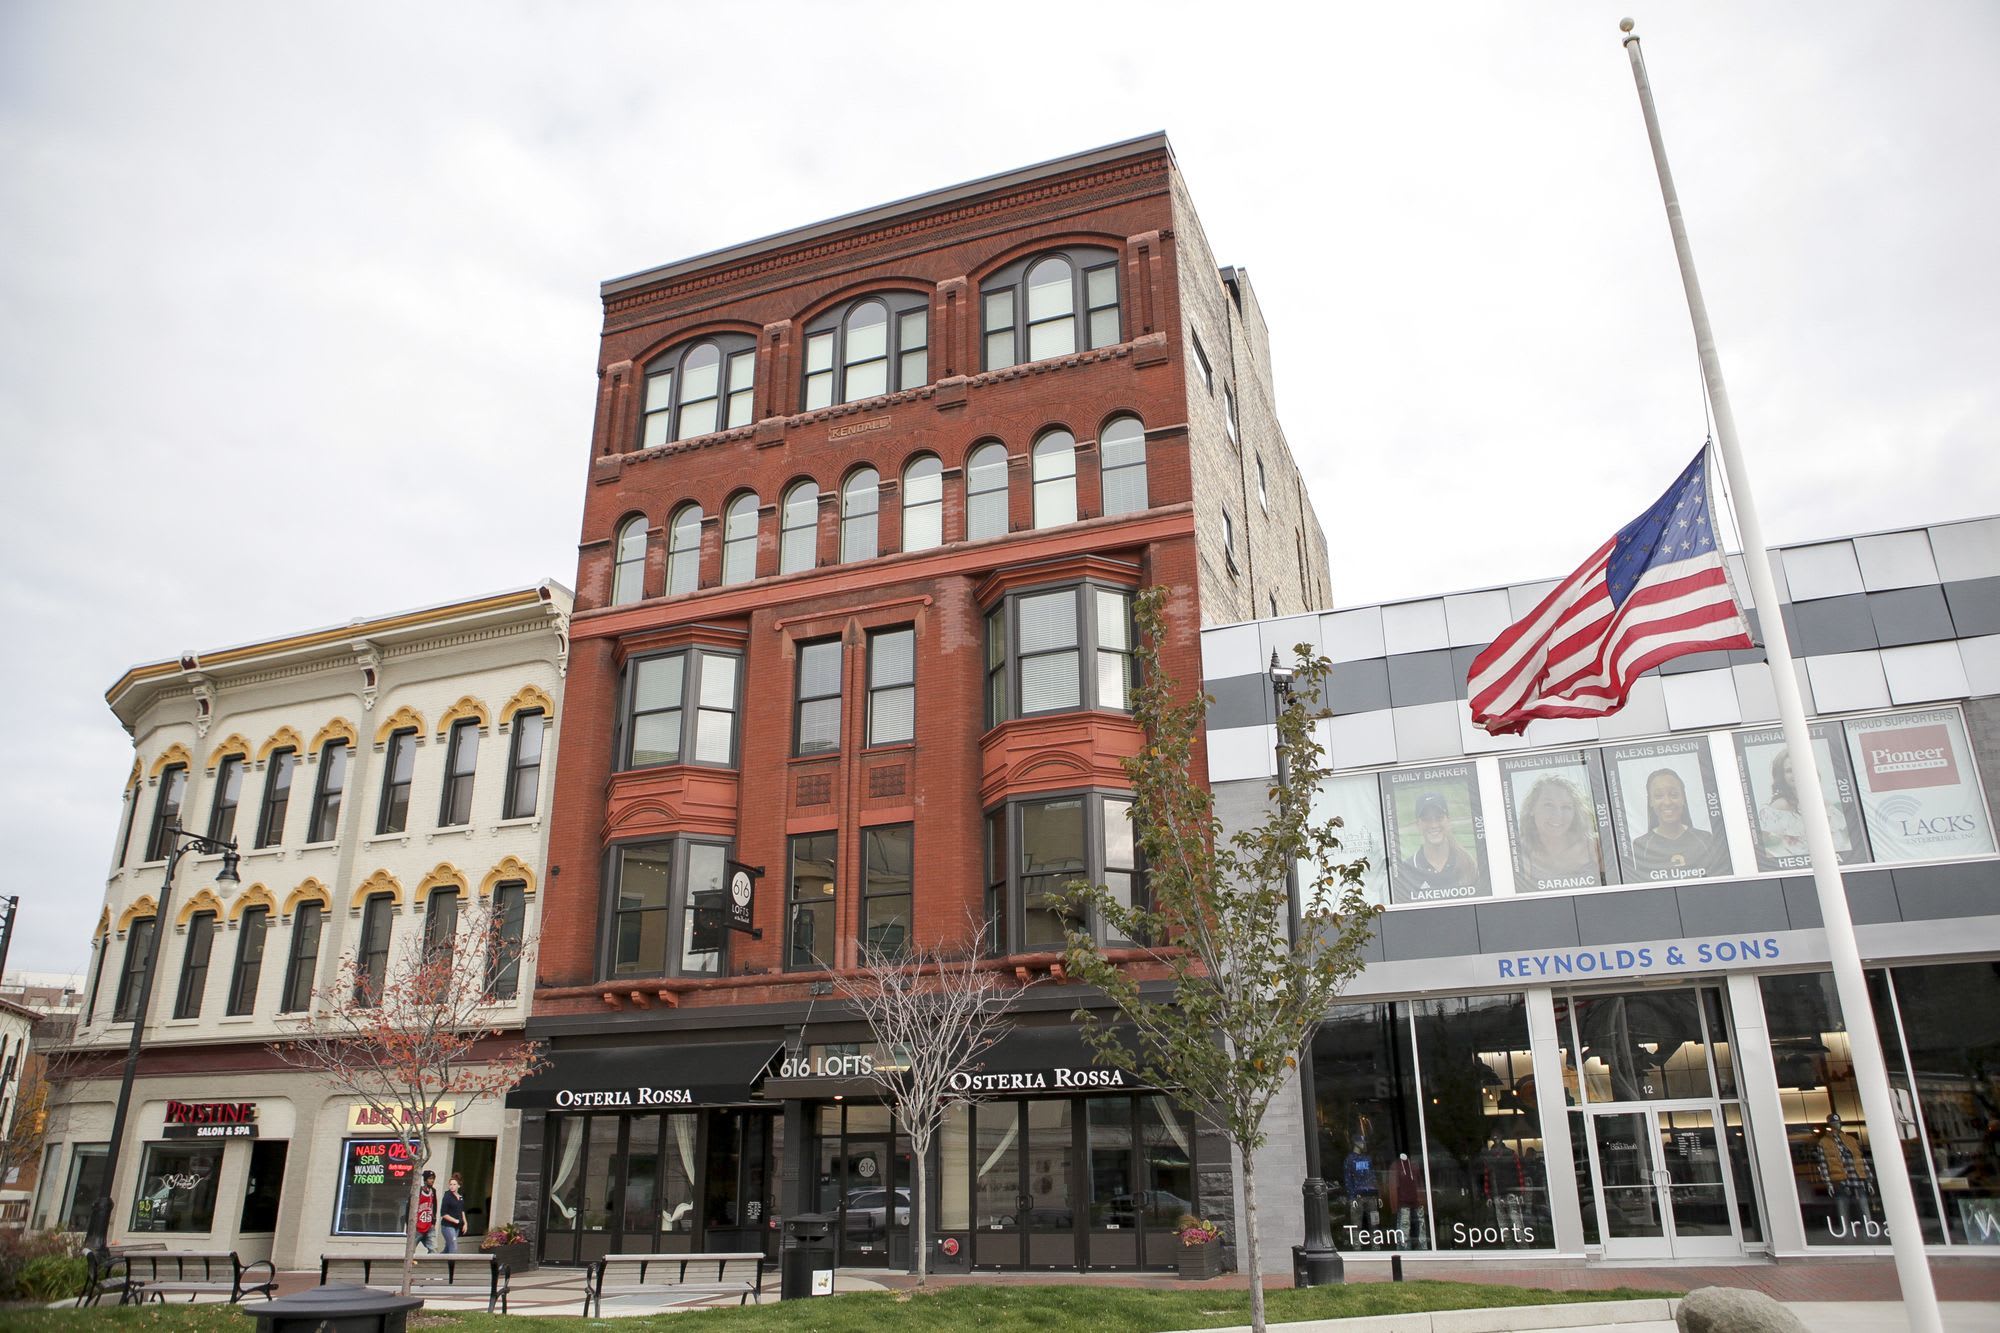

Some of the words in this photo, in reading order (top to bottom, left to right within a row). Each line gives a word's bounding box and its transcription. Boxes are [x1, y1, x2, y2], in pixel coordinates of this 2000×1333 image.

[832, 419, 888, 437] KENDALL
[1848, 719, 1882, 731] PROUD
[1885, 712, 1953, 727] SUPPORTERS
[1744, 731, 1785, 744] MARIA
[1615, 747, 1654, 759] ALEXIS
[1657, 742, 1699, 754] BASKIN
[1871, 747, 1944, 765] Pioneer
[1505, 755, 1552, 769] MADELYN
[1555, 752, 1591, 764] MILLER
[1392, 771, 1421, 783] EMILY
[1425, 767, 1468, 780] BARKER
[1837, 778, 1851, 803] 2015
[1707, 793, 1720, 817] 2015
[1597, 803, 1608, 827] 2015
[1474, 816, 1485, 840] 2015
[1900, 814, 1976, 837] LACKS
[1778, 852, 1843, 868] HESPA
[1650, 869, 1668, 880] GR
[1671, 867, 1706, 880] Uprep
[733, 879, 749, 899] 616
[1537, 875, 1595, 890] SARANAC
[1410, 886, 1476, 900] LAKEWOOD
[731, 904, 749, 917] LOFTS
[1498, 948, 1653, 978] REYNOLDS
[1666, 946, 1686, 965] &
[1698, 938, 1780, 963] SONS
[780, 1058, 811, 1078] 616
[817, 1055, 873, 1077] LOFTS
[950, 1072, 1046, 1090] OSTERIA
[1054, 1068, 1124, 1088] ROSSA
[556, 1089, 631, 1107] OSTERIA
[638, 1087, 693, 1104] ROSSA
[1643, 1085, 1653, 1094] 12
[163, 1100, 257, 1124] PRISTINE
[356, 1107, 395, 1125] ABC
[197, 1127, 224, 1136] SALON
[225, 1127, 232, 1135] &
[233, 1126, 250, 1136] SPA
[356, 1144, 386, 1156] NAILS
[360, 1156, 380, 1165] SPA
[859, 1161, 875, 1173] 616
[354, 1165, 384, 1175] WAXING
[353, 1174, 384, 1184] 776-6000
[419, 1211, 432, 1223] 45
[1343, 1225, 1405, 1245] Team
[1453, 1222, 1535, 1248] Sports
